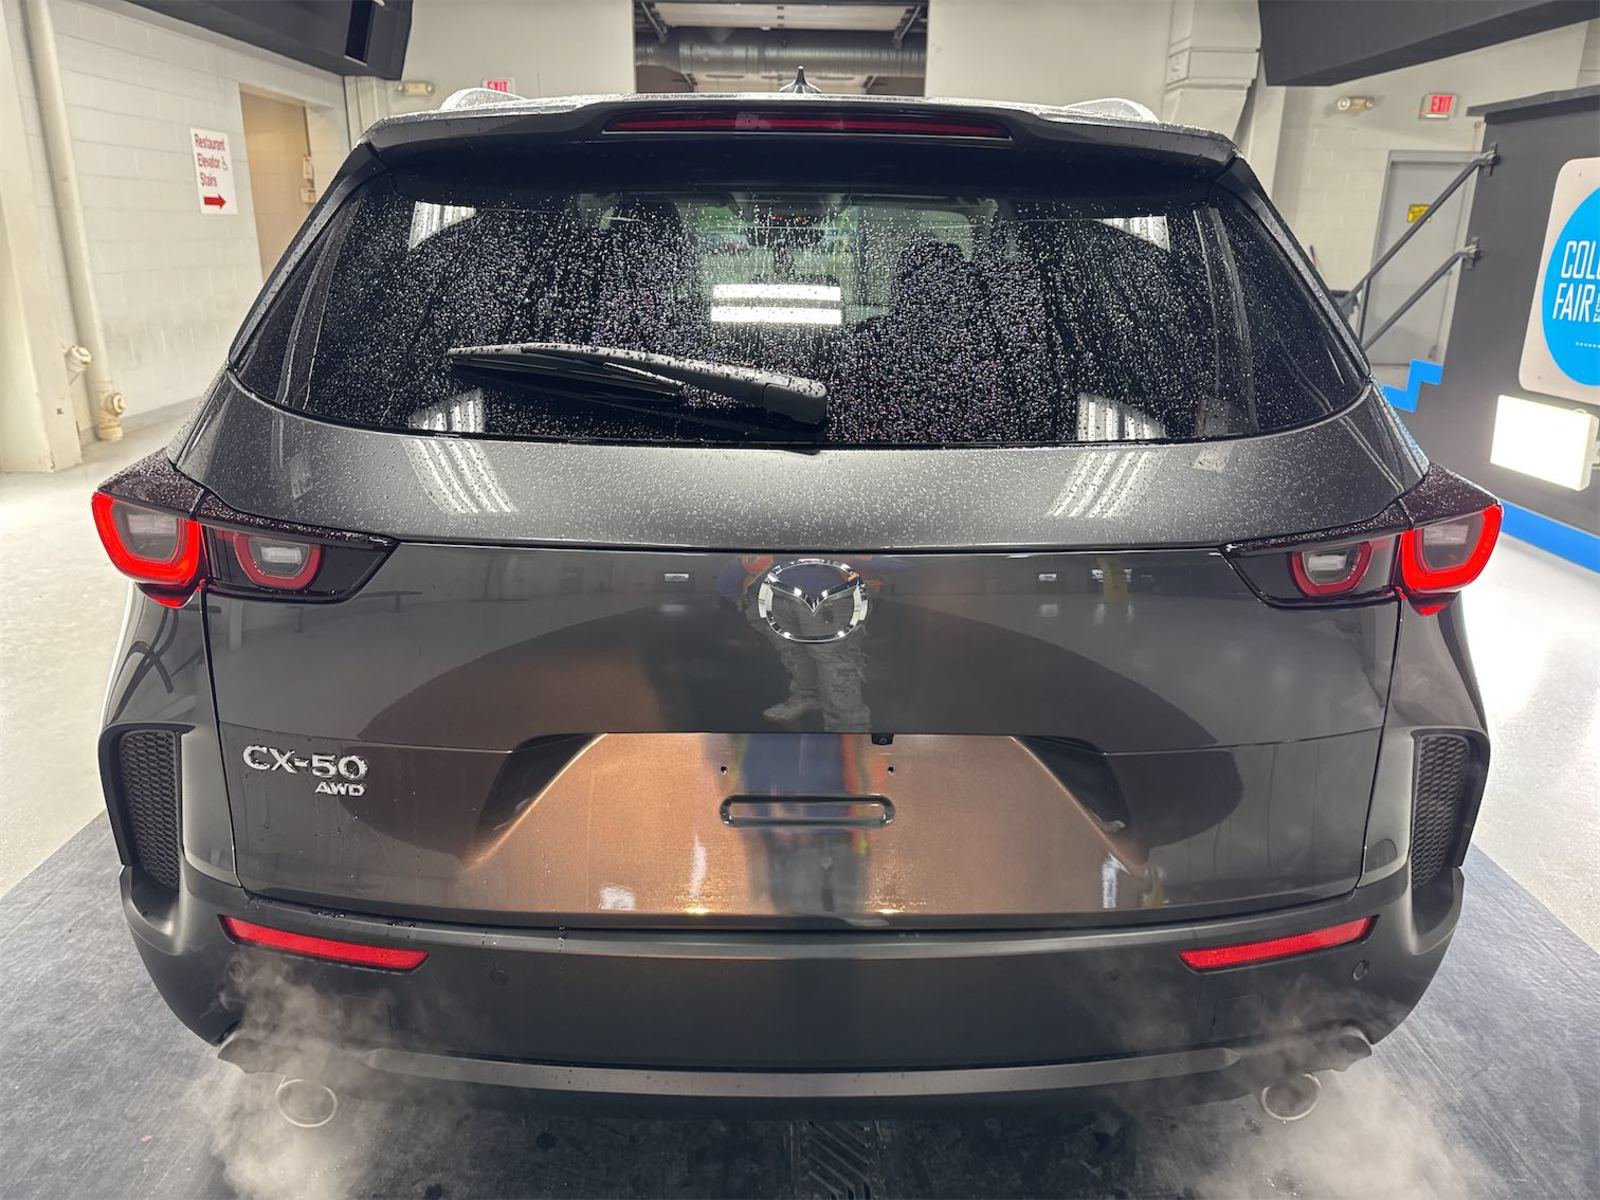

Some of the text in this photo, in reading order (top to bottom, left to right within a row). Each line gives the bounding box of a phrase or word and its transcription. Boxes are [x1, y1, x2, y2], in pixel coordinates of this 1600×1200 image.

[1430, 95, 1453, 113] EXIT
[194, 133, 226, 151] Restaurant
[197, 153, 220, 169] Elevator
[199, 172, 218, 188] Stairs
[1560, 240, 1600, 280] COL
[1552, 282, 1596, 323] FAIR
[243, 744, 368, 780] CX-50
[314, 781, 366, 797] AWD
